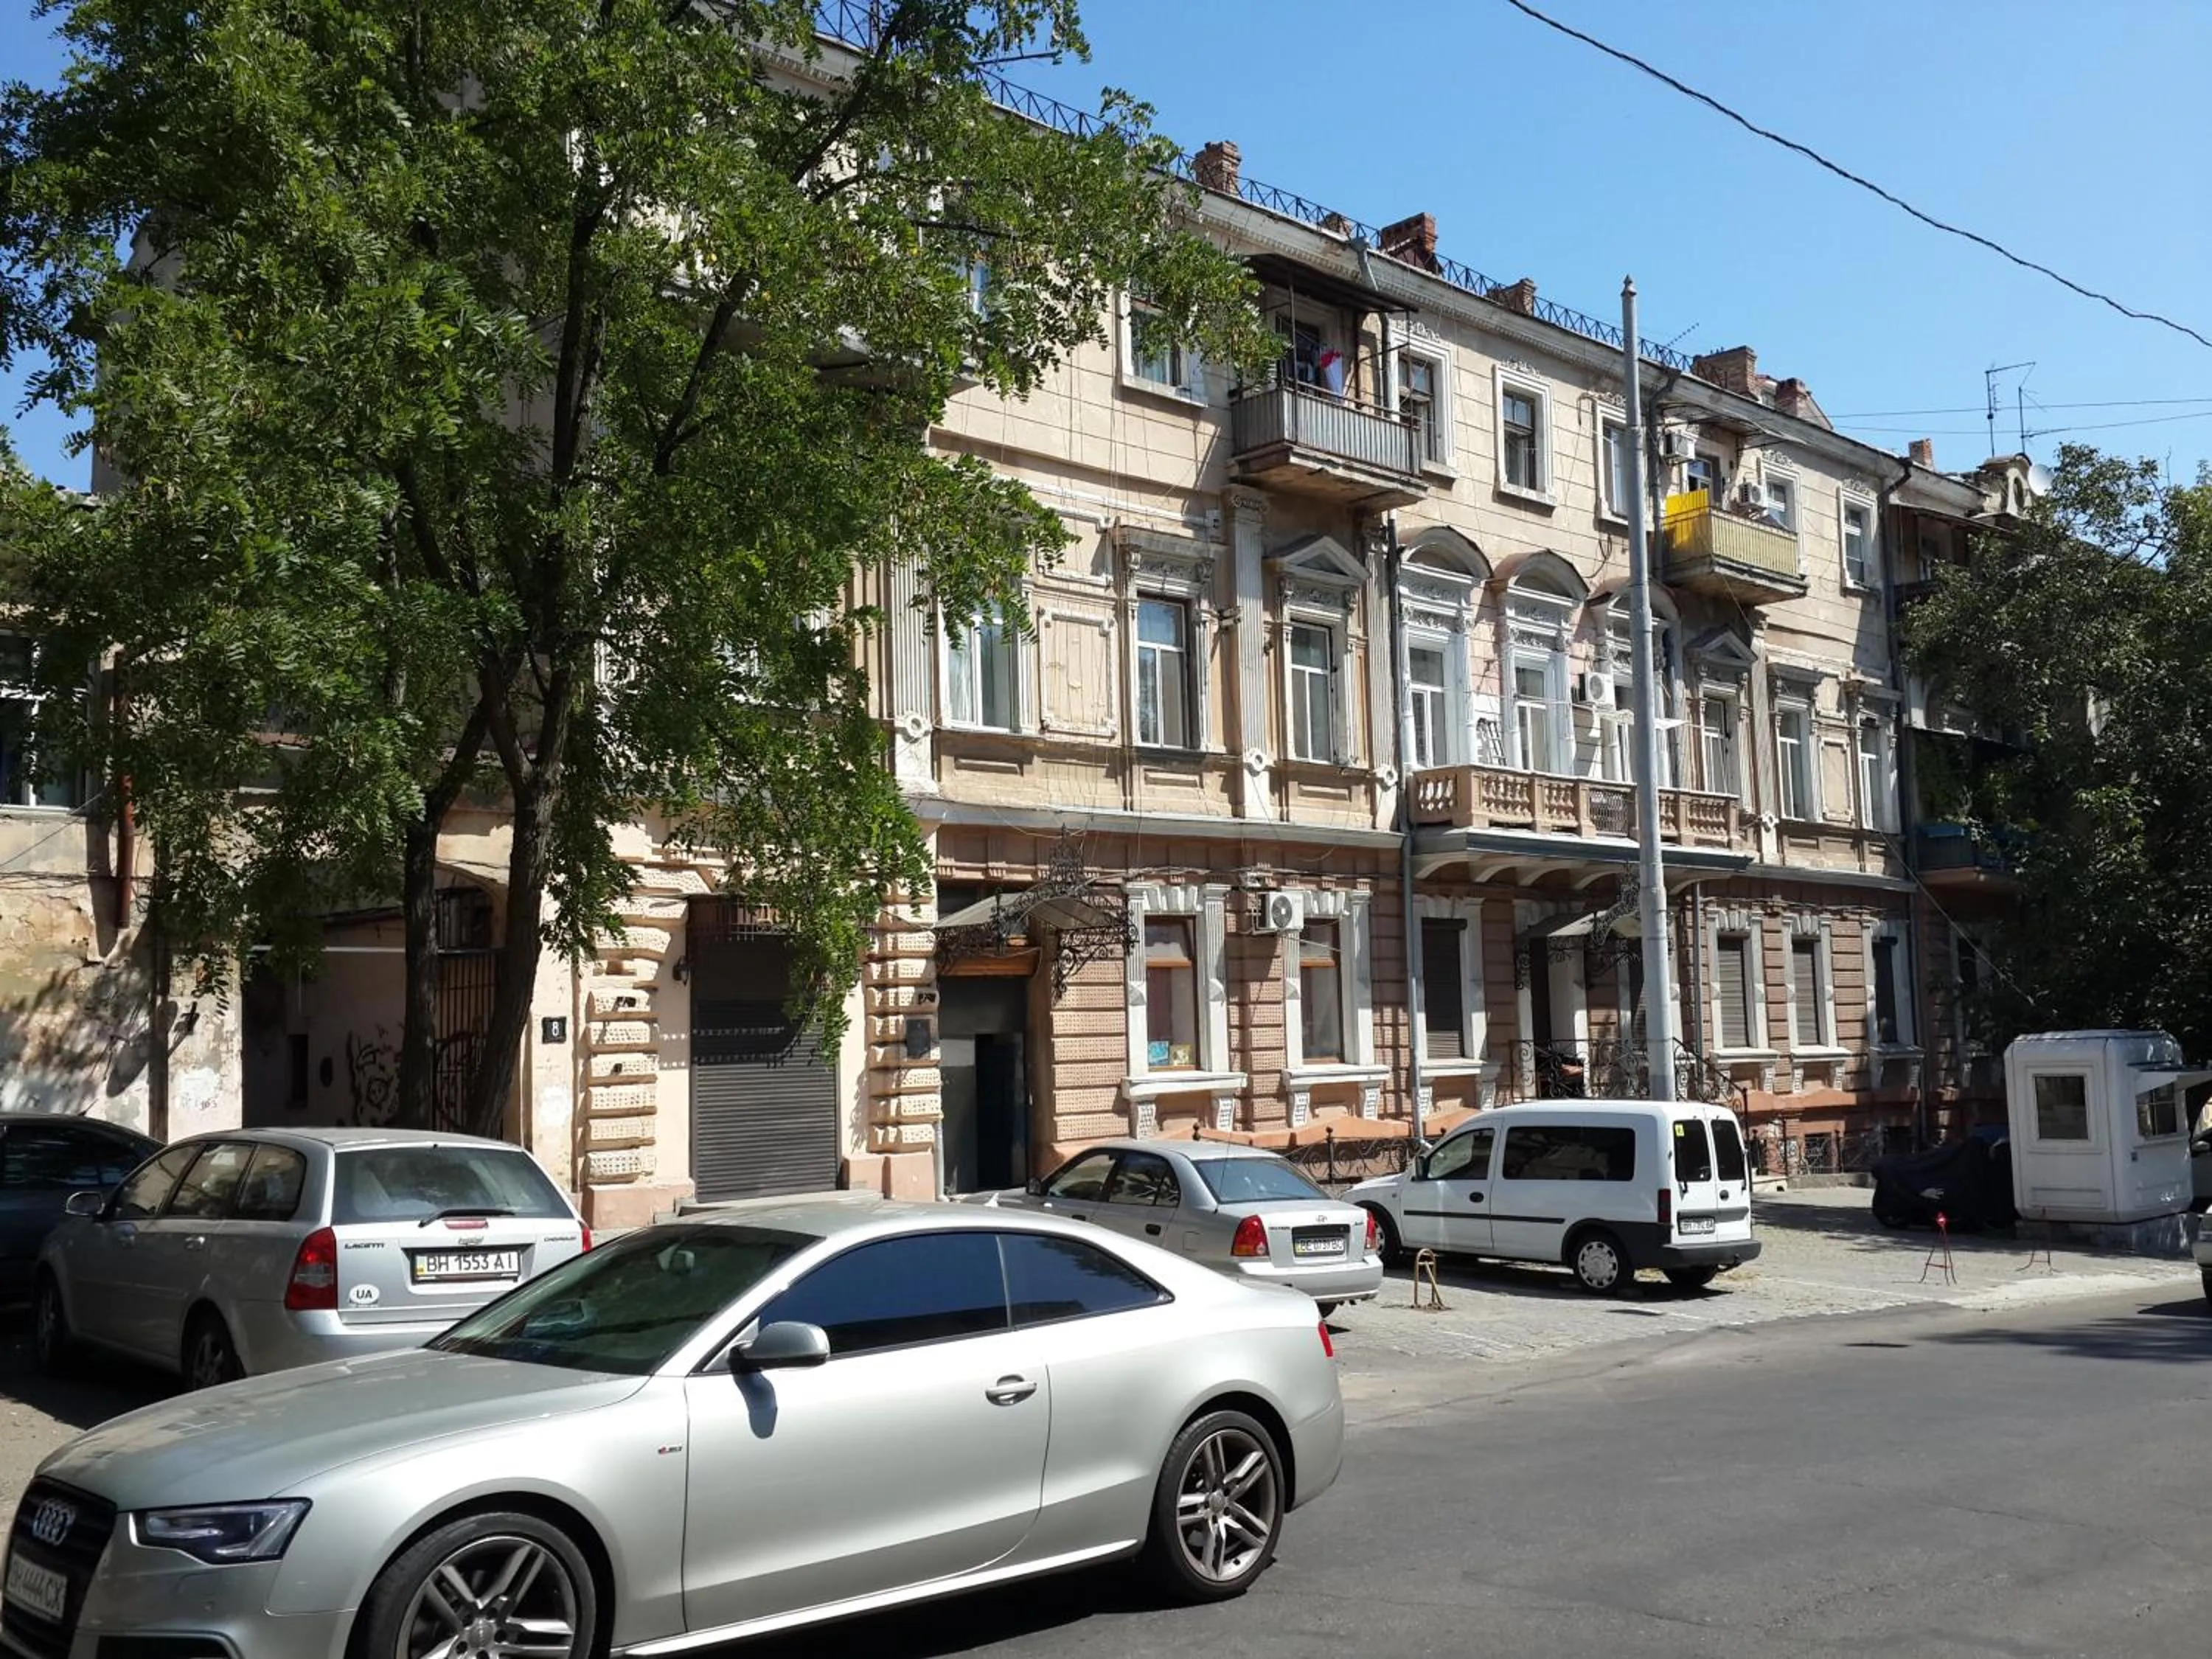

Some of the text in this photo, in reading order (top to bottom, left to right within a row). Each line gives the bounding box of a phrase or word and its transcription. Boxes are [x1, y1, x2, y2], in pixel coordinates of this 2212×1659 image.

[552, 1021, 559, 1036] 8
[427, 1255, 449, 1272] BH
[454, 1253, 489, 1271] 1553
[356, 1290, 372, 1298] UA
